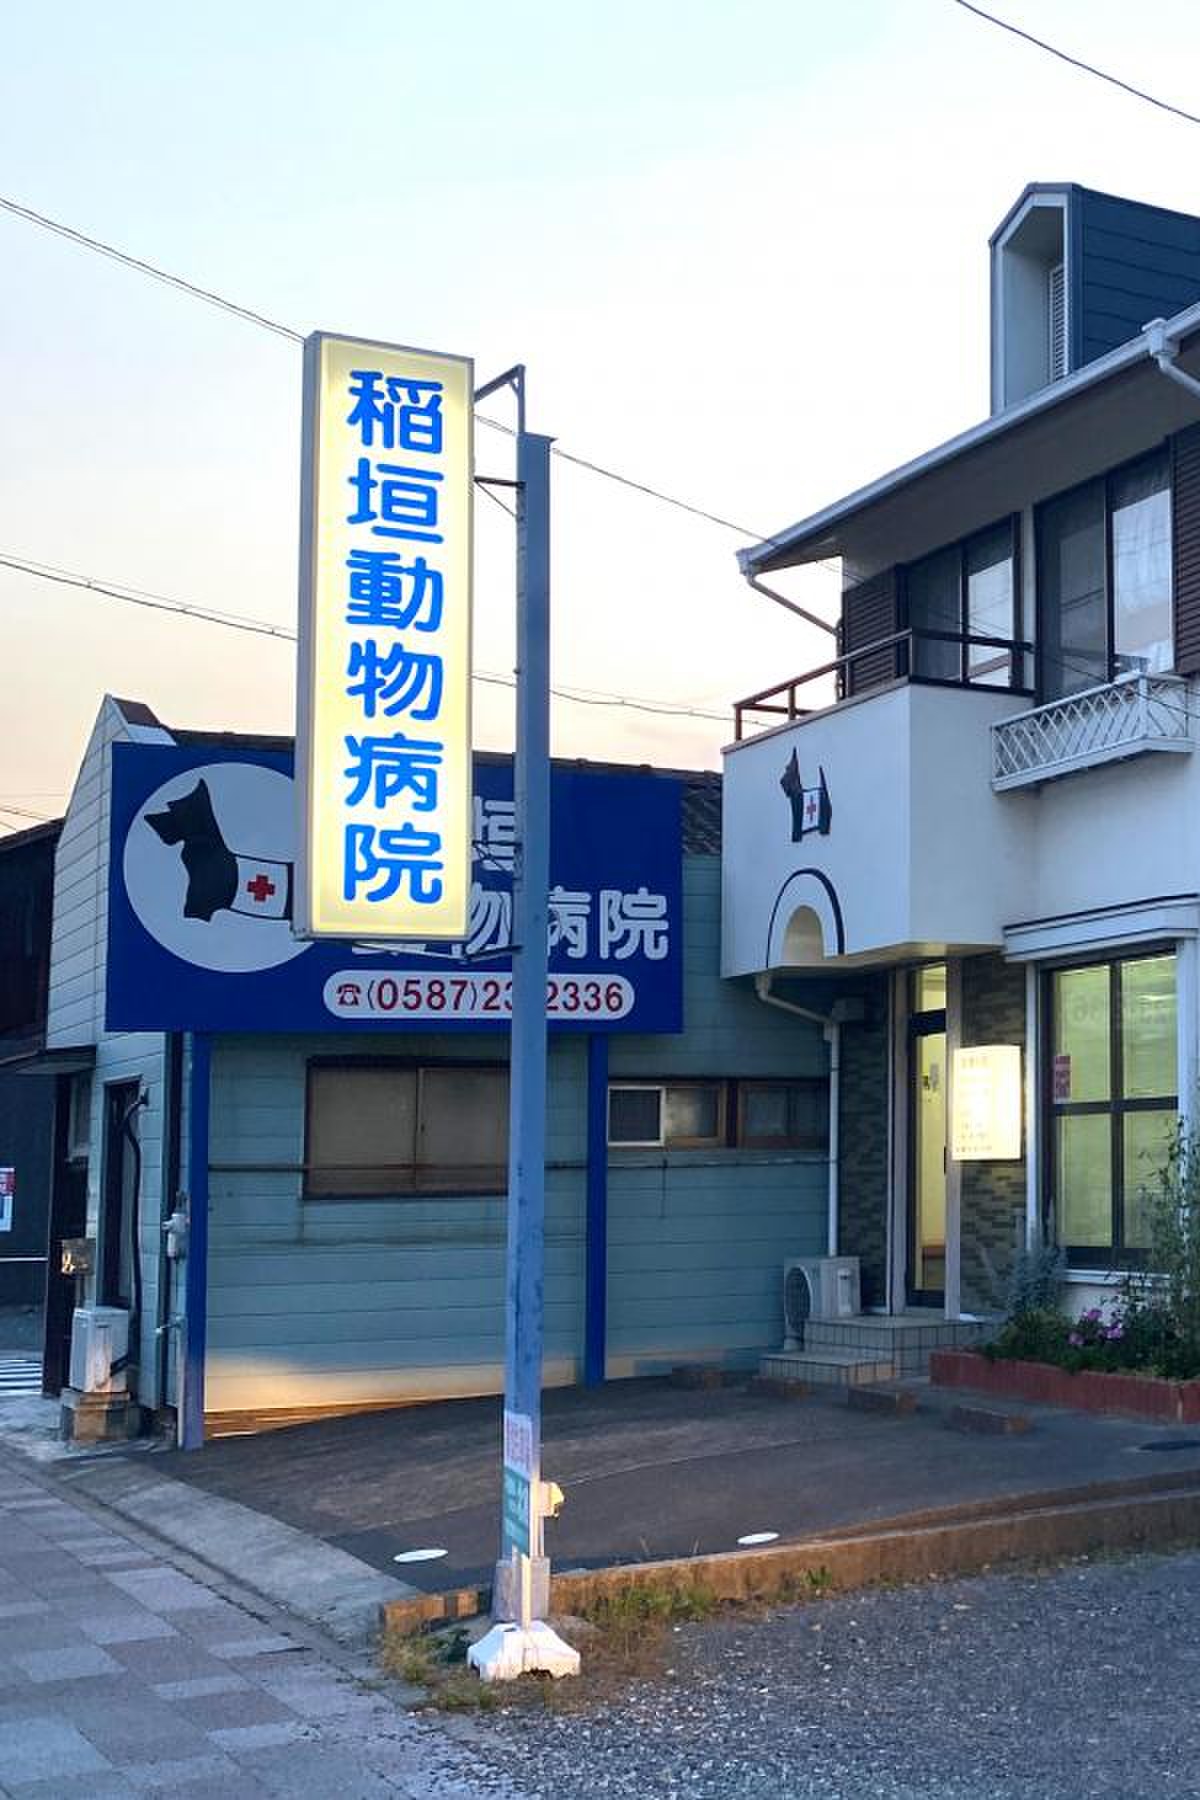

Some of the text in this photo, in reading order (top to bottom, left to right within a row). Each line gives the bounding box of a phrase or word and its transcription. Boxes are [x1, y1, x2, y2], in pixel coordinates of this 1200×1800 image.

[345, 369, 444, 905] 稲垣動物病院
